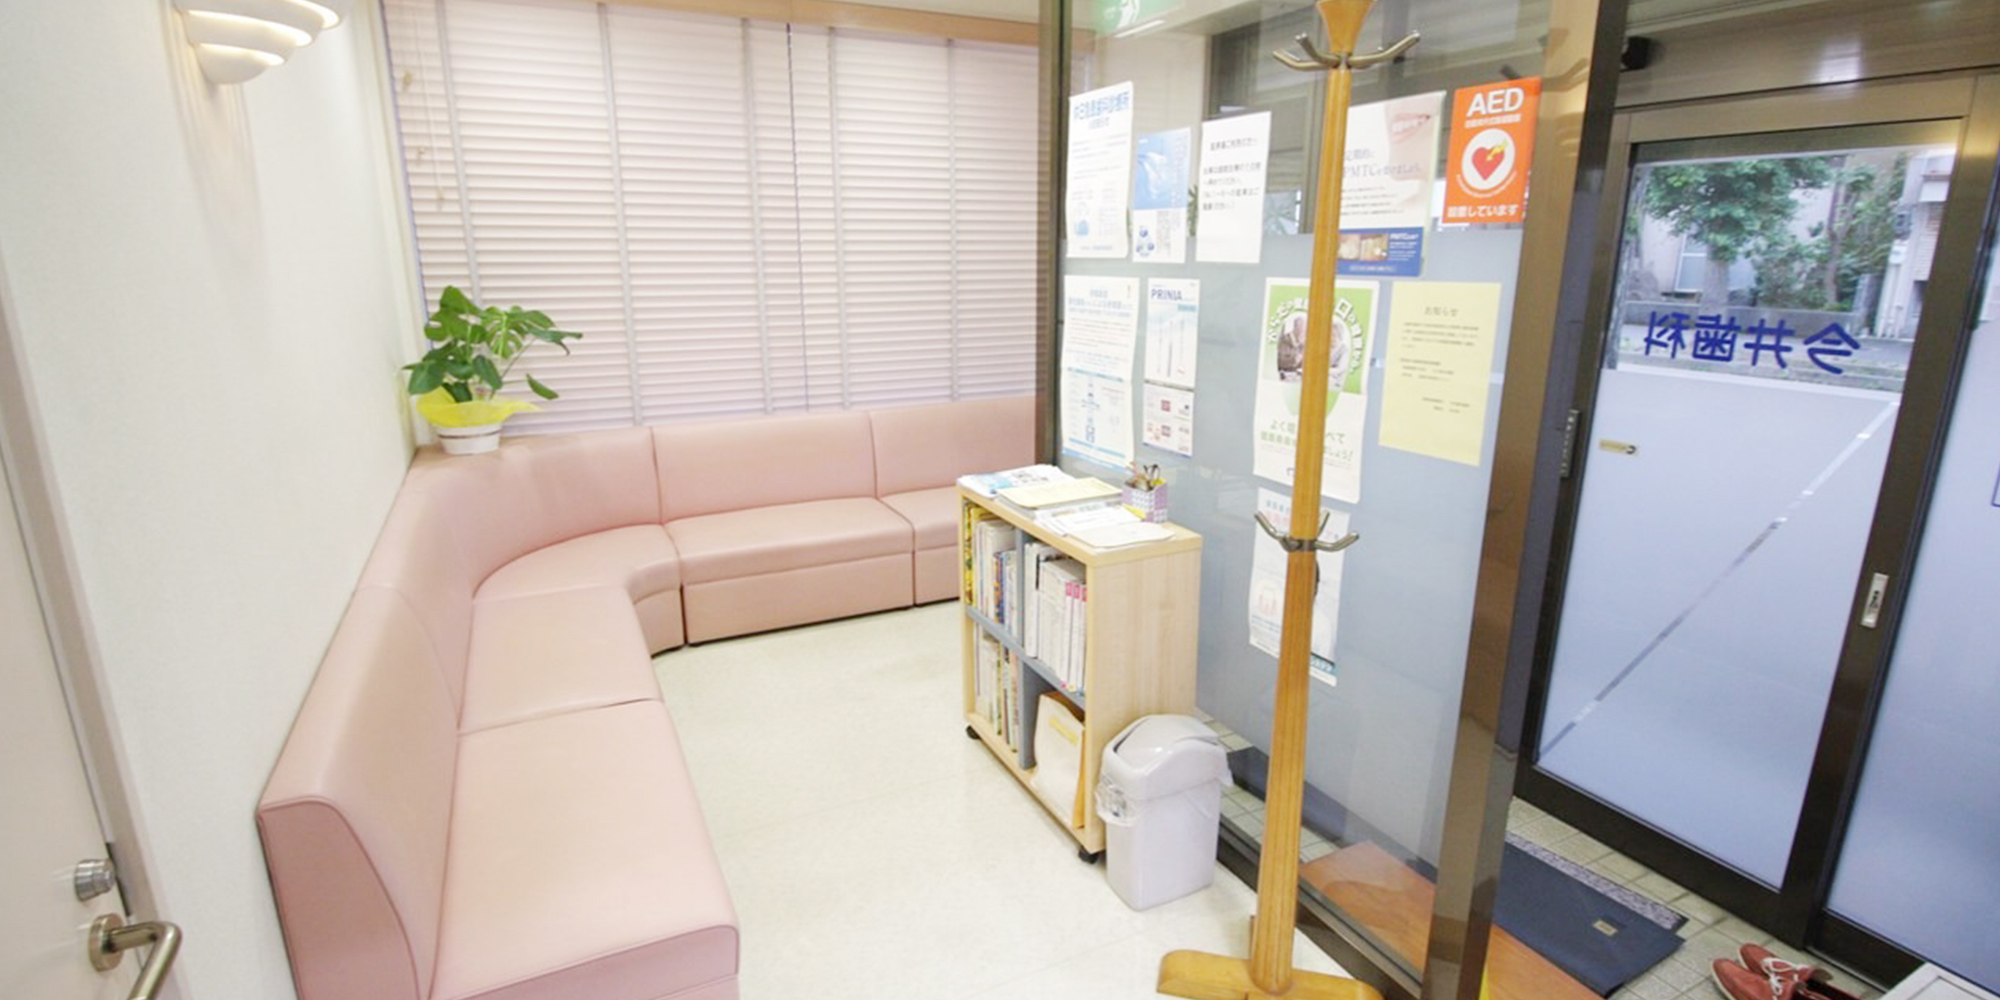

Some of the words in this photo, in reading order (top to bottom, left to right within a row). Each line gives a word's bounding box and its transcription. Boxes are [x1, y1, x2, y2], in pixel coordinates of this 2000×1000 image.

[1466, 87, 1524, 117] AED
[1447, 204, 1520, 218] 設置しています
[1150, 288, 1183, 301] PRINIA
[1423, 306, 1459, 317] お知らせ
